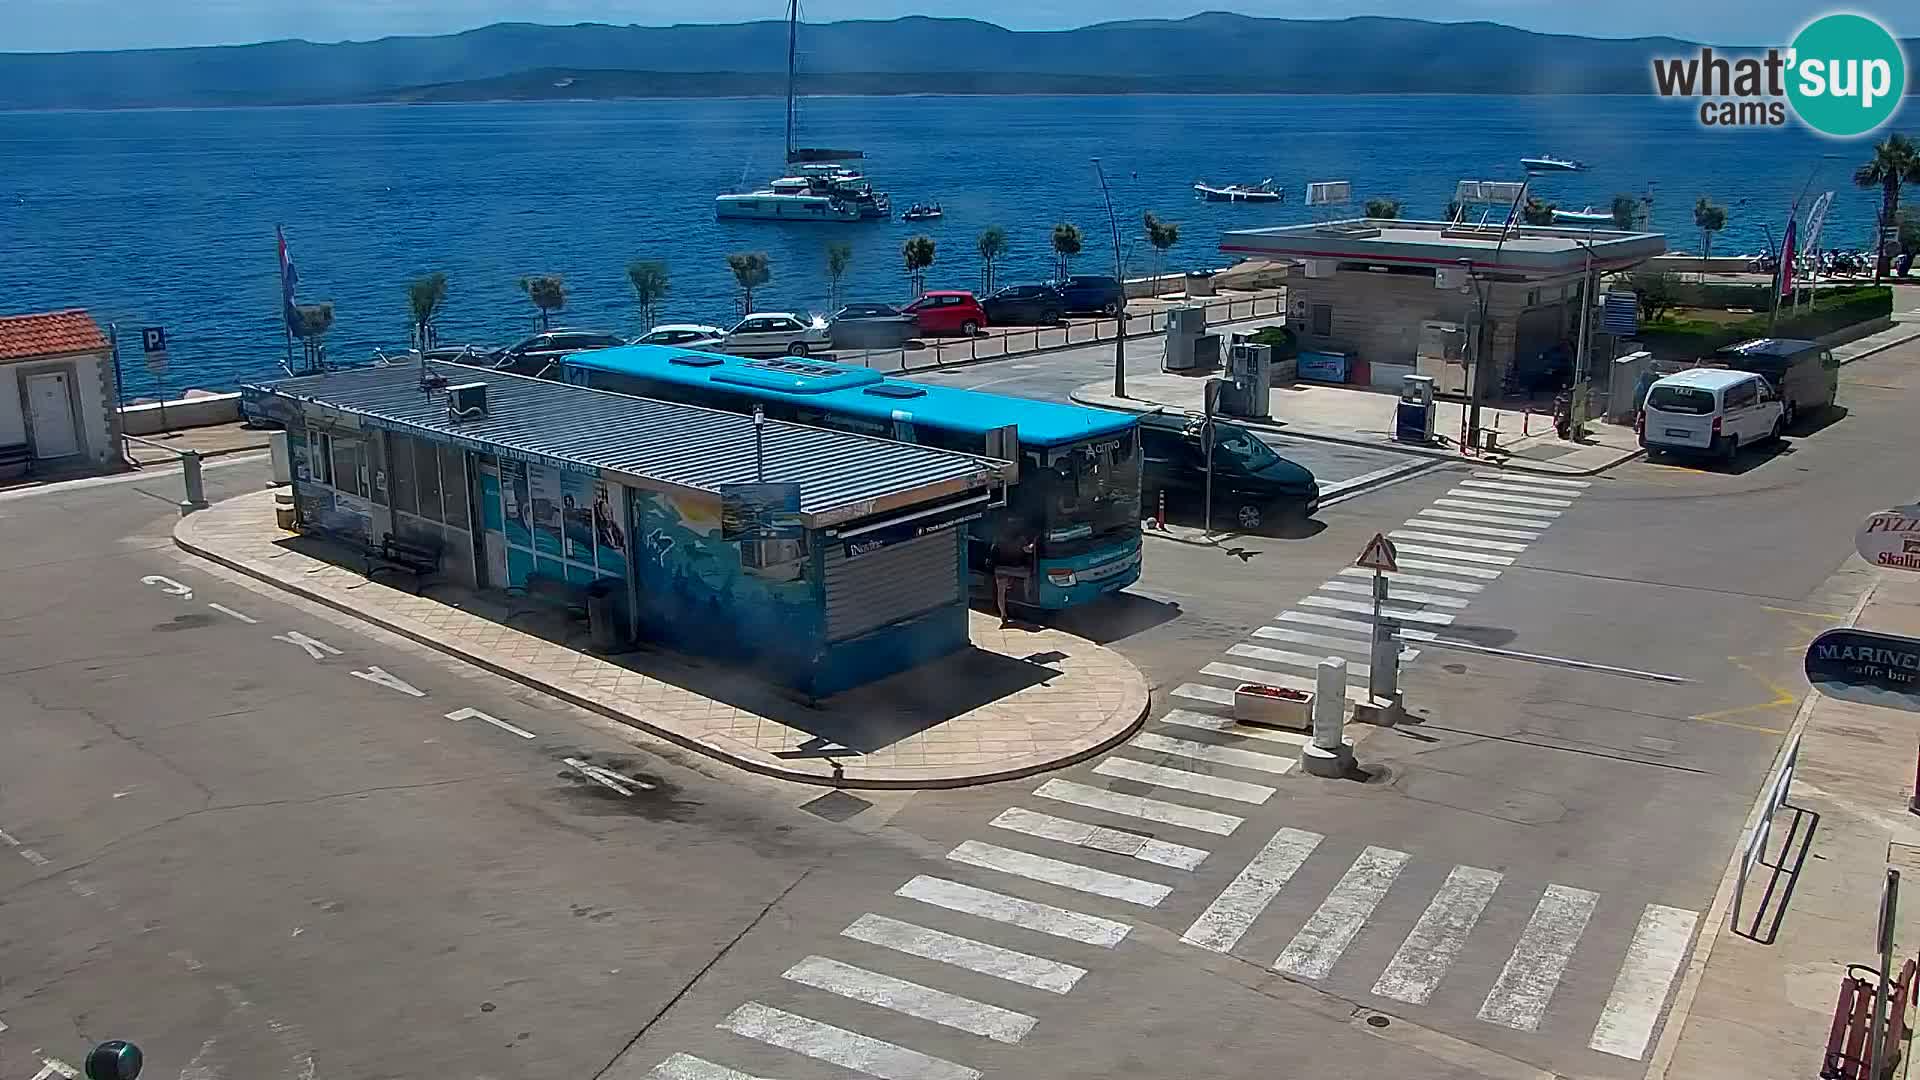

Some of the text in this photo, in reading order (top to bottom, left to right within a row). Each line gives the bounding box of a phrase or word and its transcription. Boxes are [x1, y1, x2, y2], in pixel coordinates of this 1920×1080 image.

[147, 330, 160, 349] P
[544, 457, 569, 472] TICKET
[570, 462, 598, 476] OFFICE
[1815, 644, 1920, 671] MARINE
[1888, 668, 1916, 683] bar
